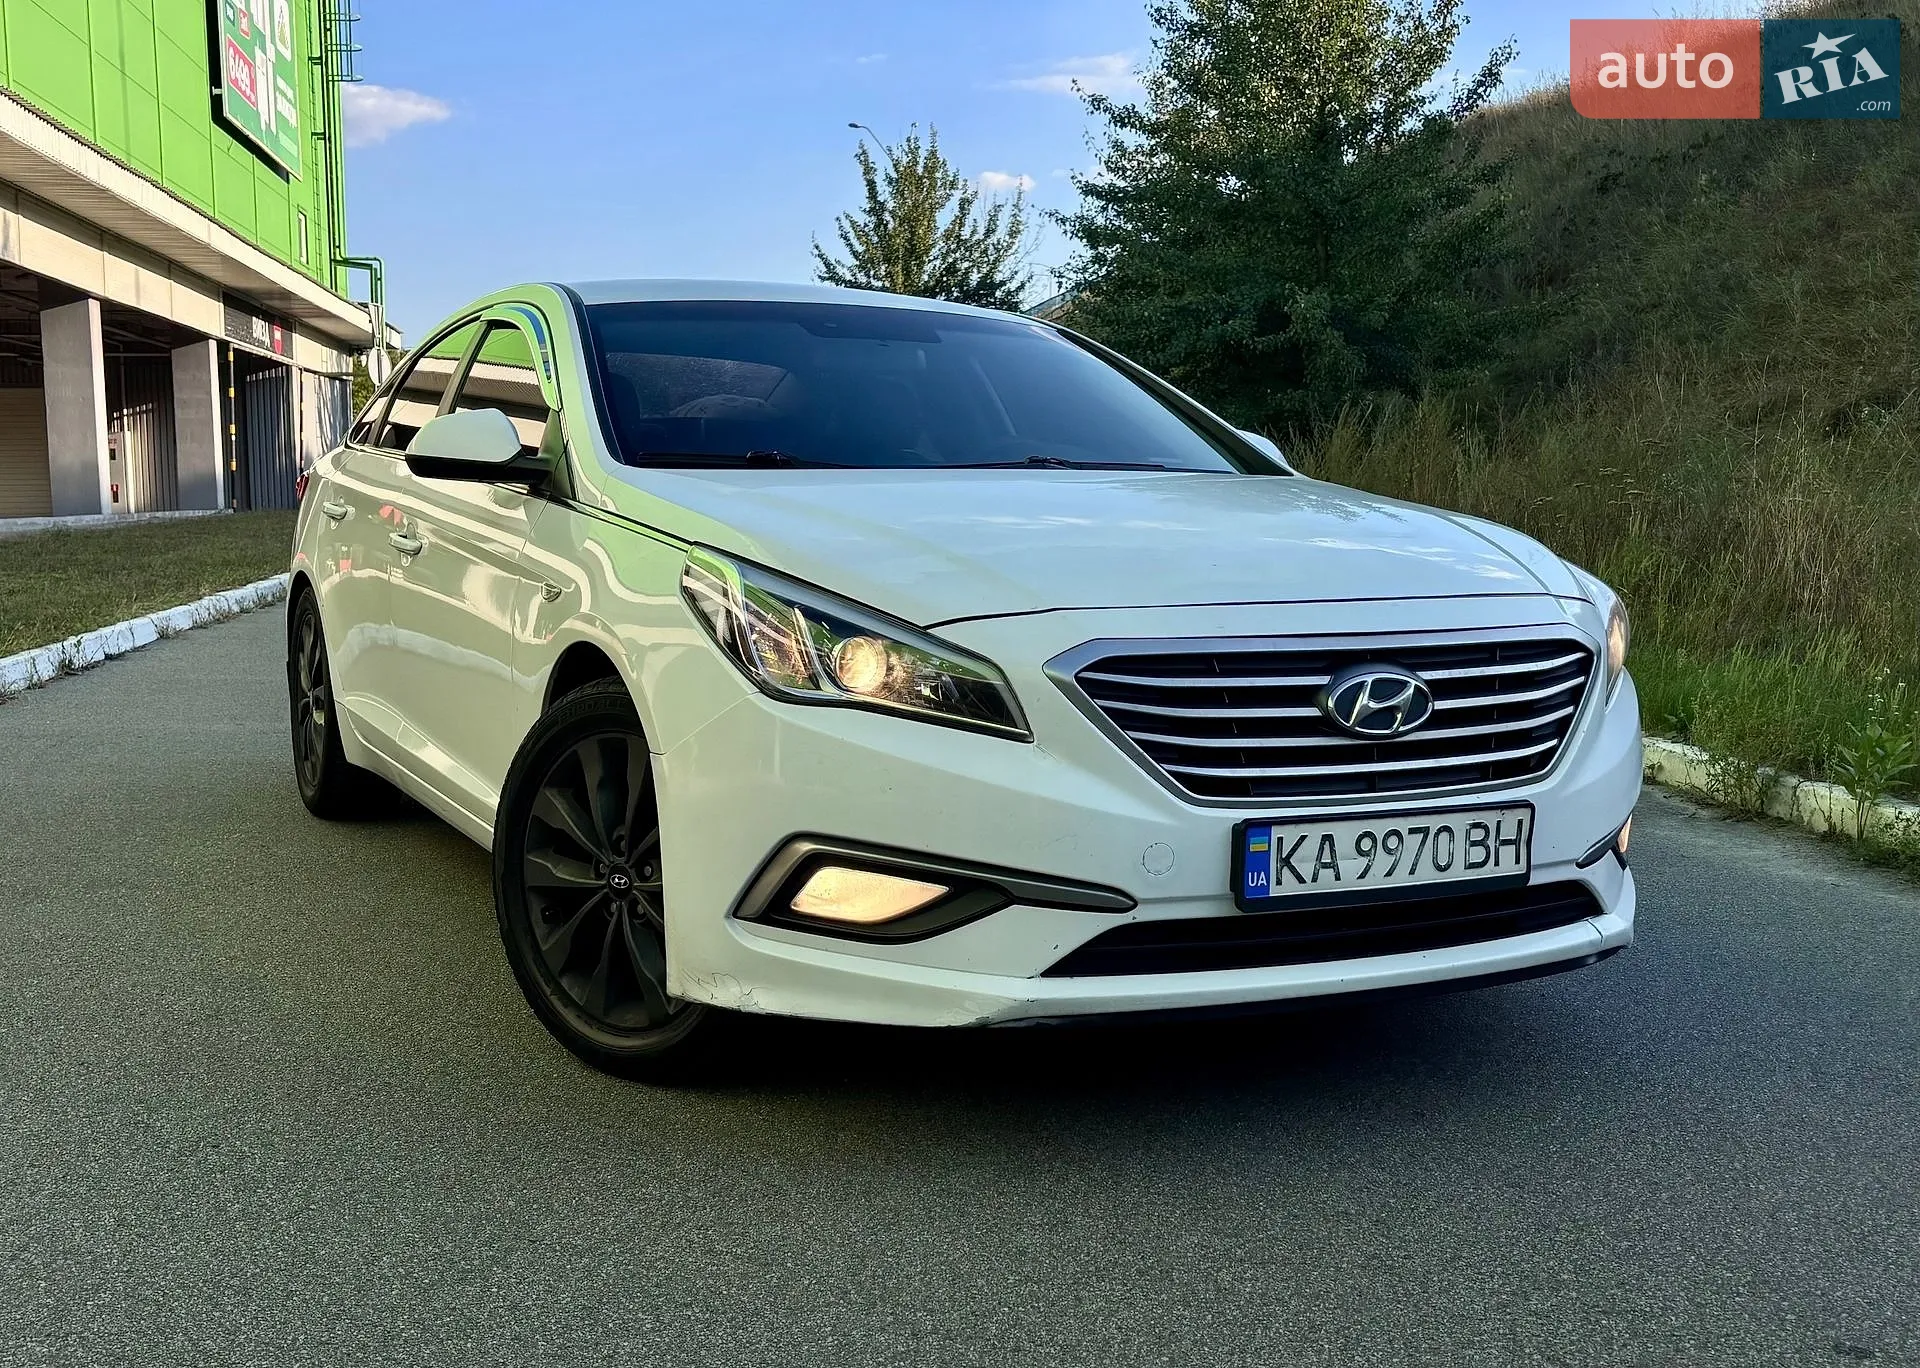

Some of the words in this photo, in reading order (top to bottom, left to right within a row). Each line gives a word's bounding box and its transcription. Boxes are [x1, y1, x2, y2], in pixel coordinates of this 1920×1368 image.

[1275, 832, 1342, 886] KA
[1354, 824, 1456, 880] 9970
[1463, 817, 1525, 871] BH
[1248, 871, 1268, 888] UA
